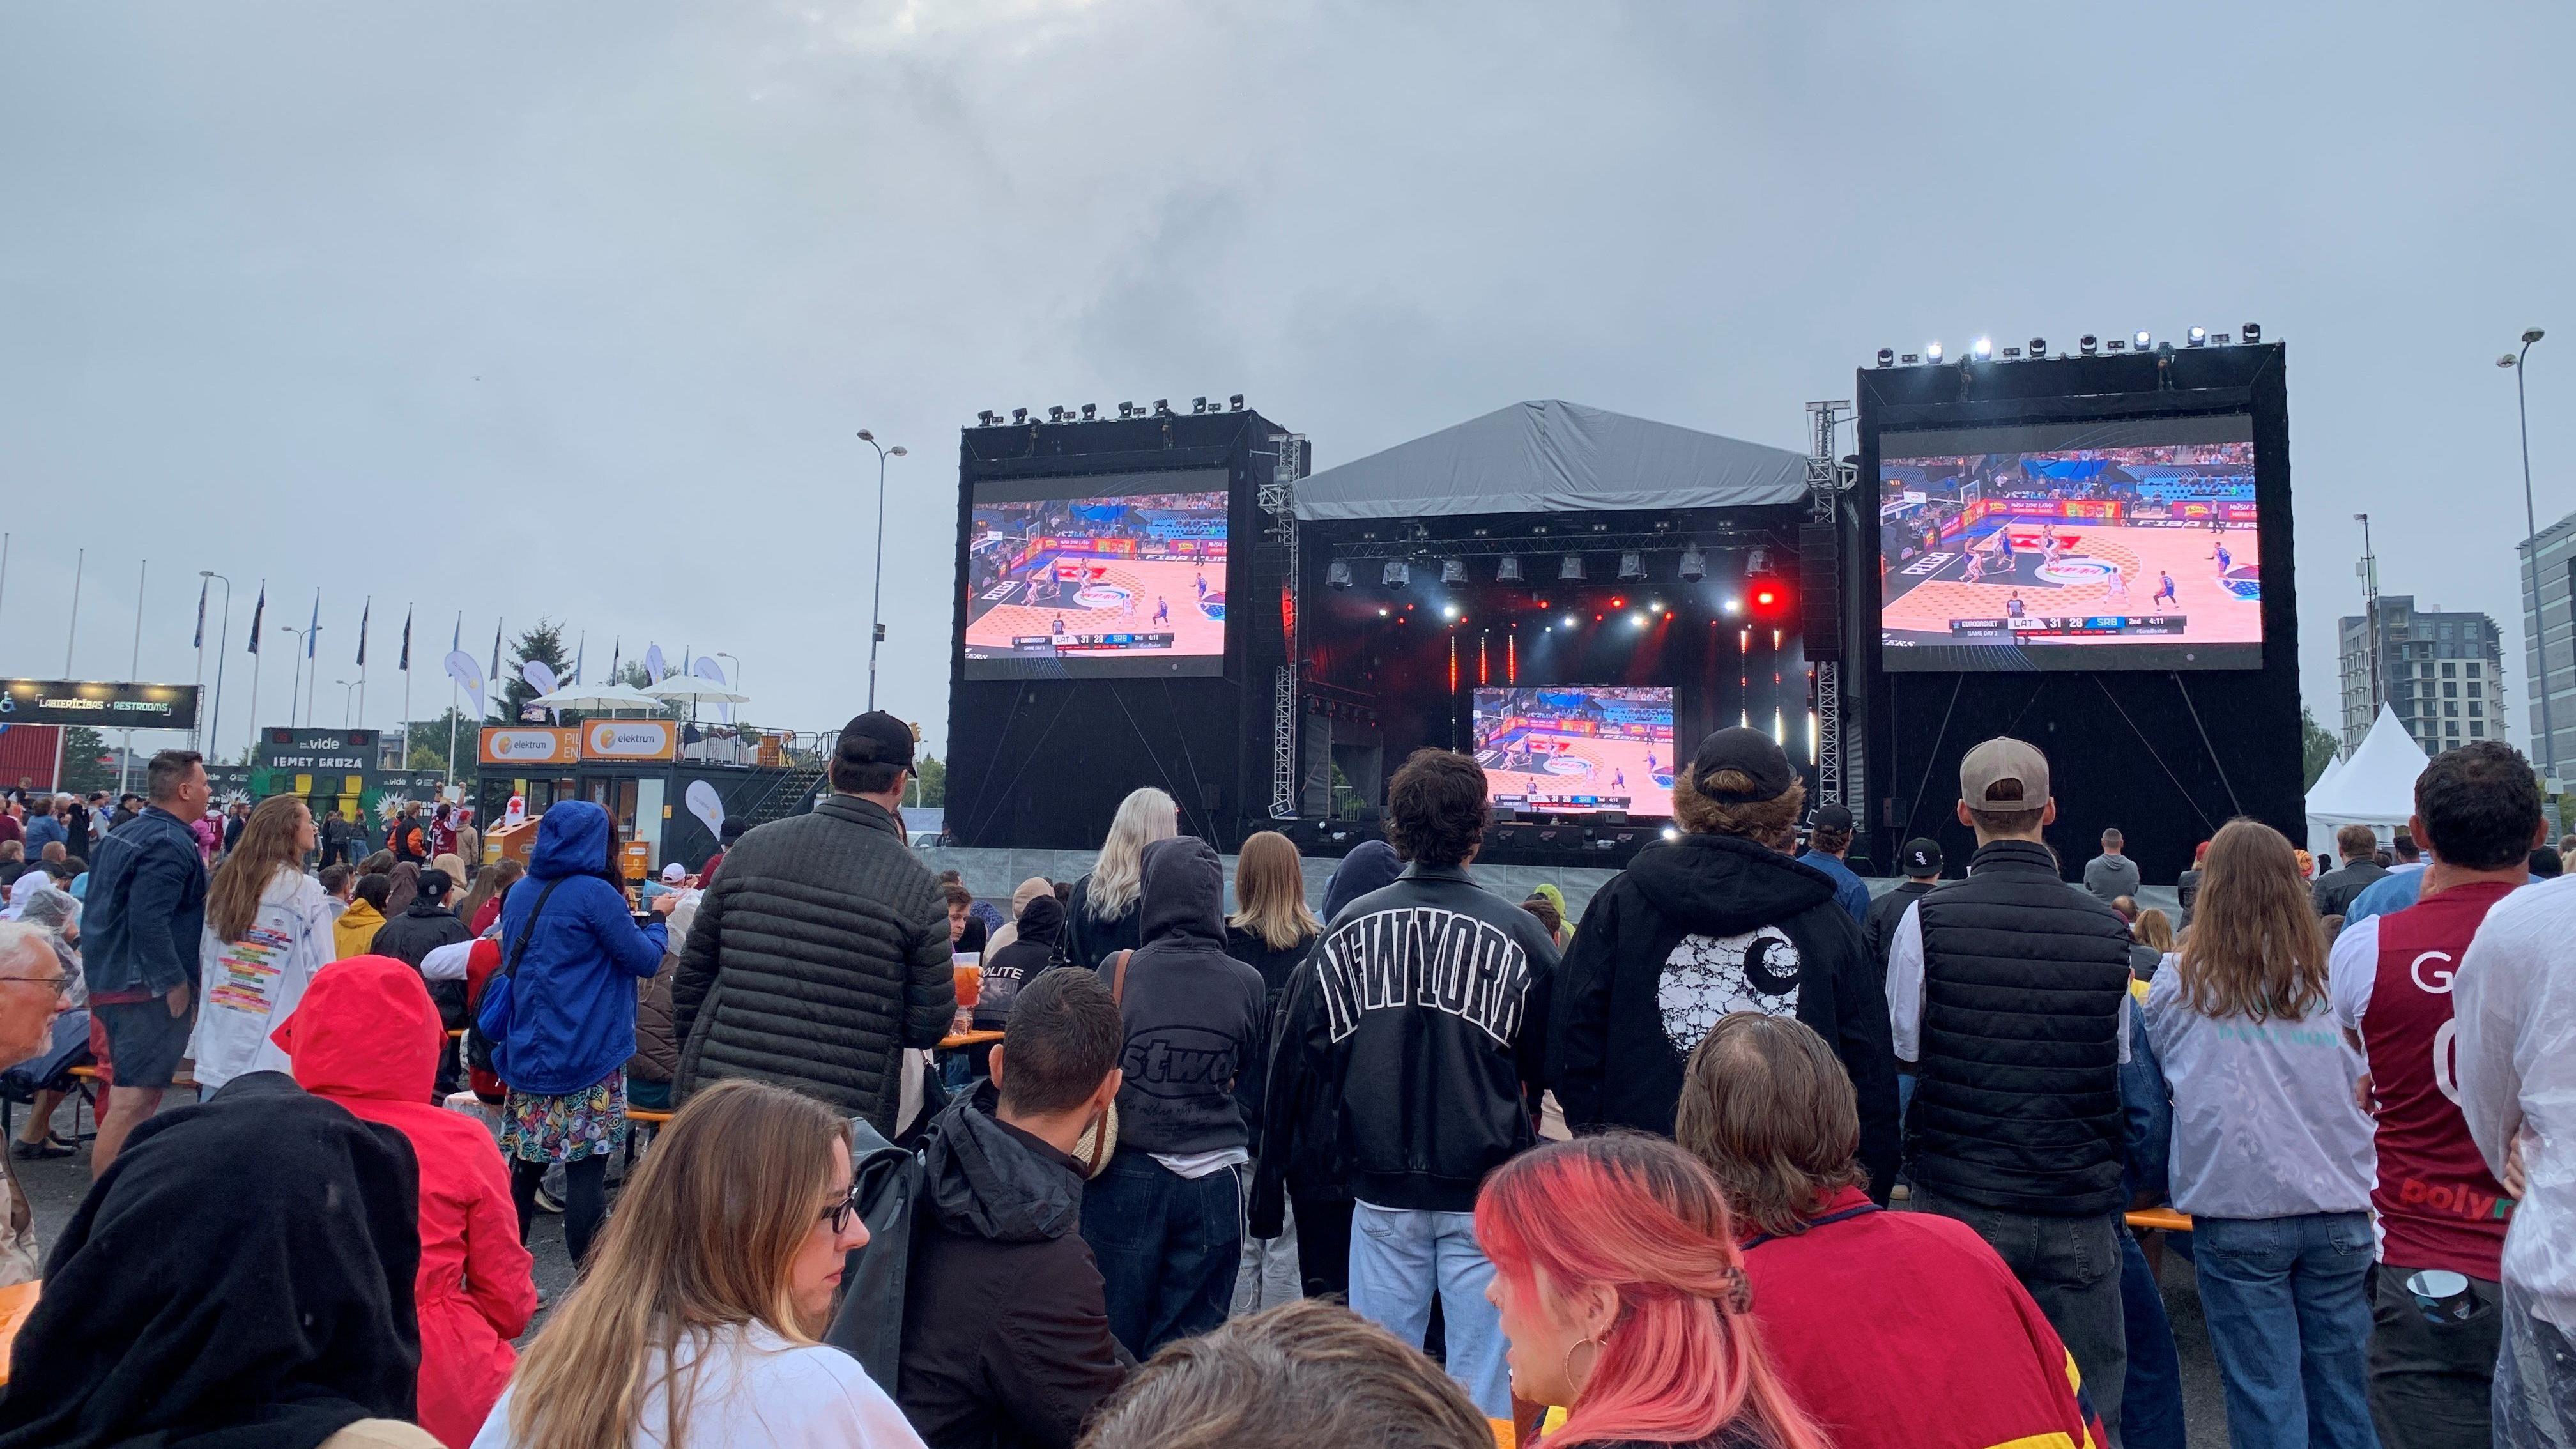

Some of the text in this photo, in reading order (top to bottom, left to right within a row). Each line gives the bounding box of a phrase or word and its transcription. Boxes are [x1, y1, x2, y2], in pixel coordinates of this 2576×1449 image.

[1900, 552, 1955, 575] RIGA
[981, 580, 1020, 601] RIGA
[2050, 618, 2062, 628] 31
[2069, 617, 2083, 627] 28
[1080, 635, 1089, 643] 31
[1094, 634, 1103, 643] 28
[113, 702, 168, 712] RESTROOMS
[310, 737, 339, 749] vide
[618, 733, 655, 743] elektrum
[514, 740, 546, 749] elektrum
[273, 756, 314, 767] IEMET
